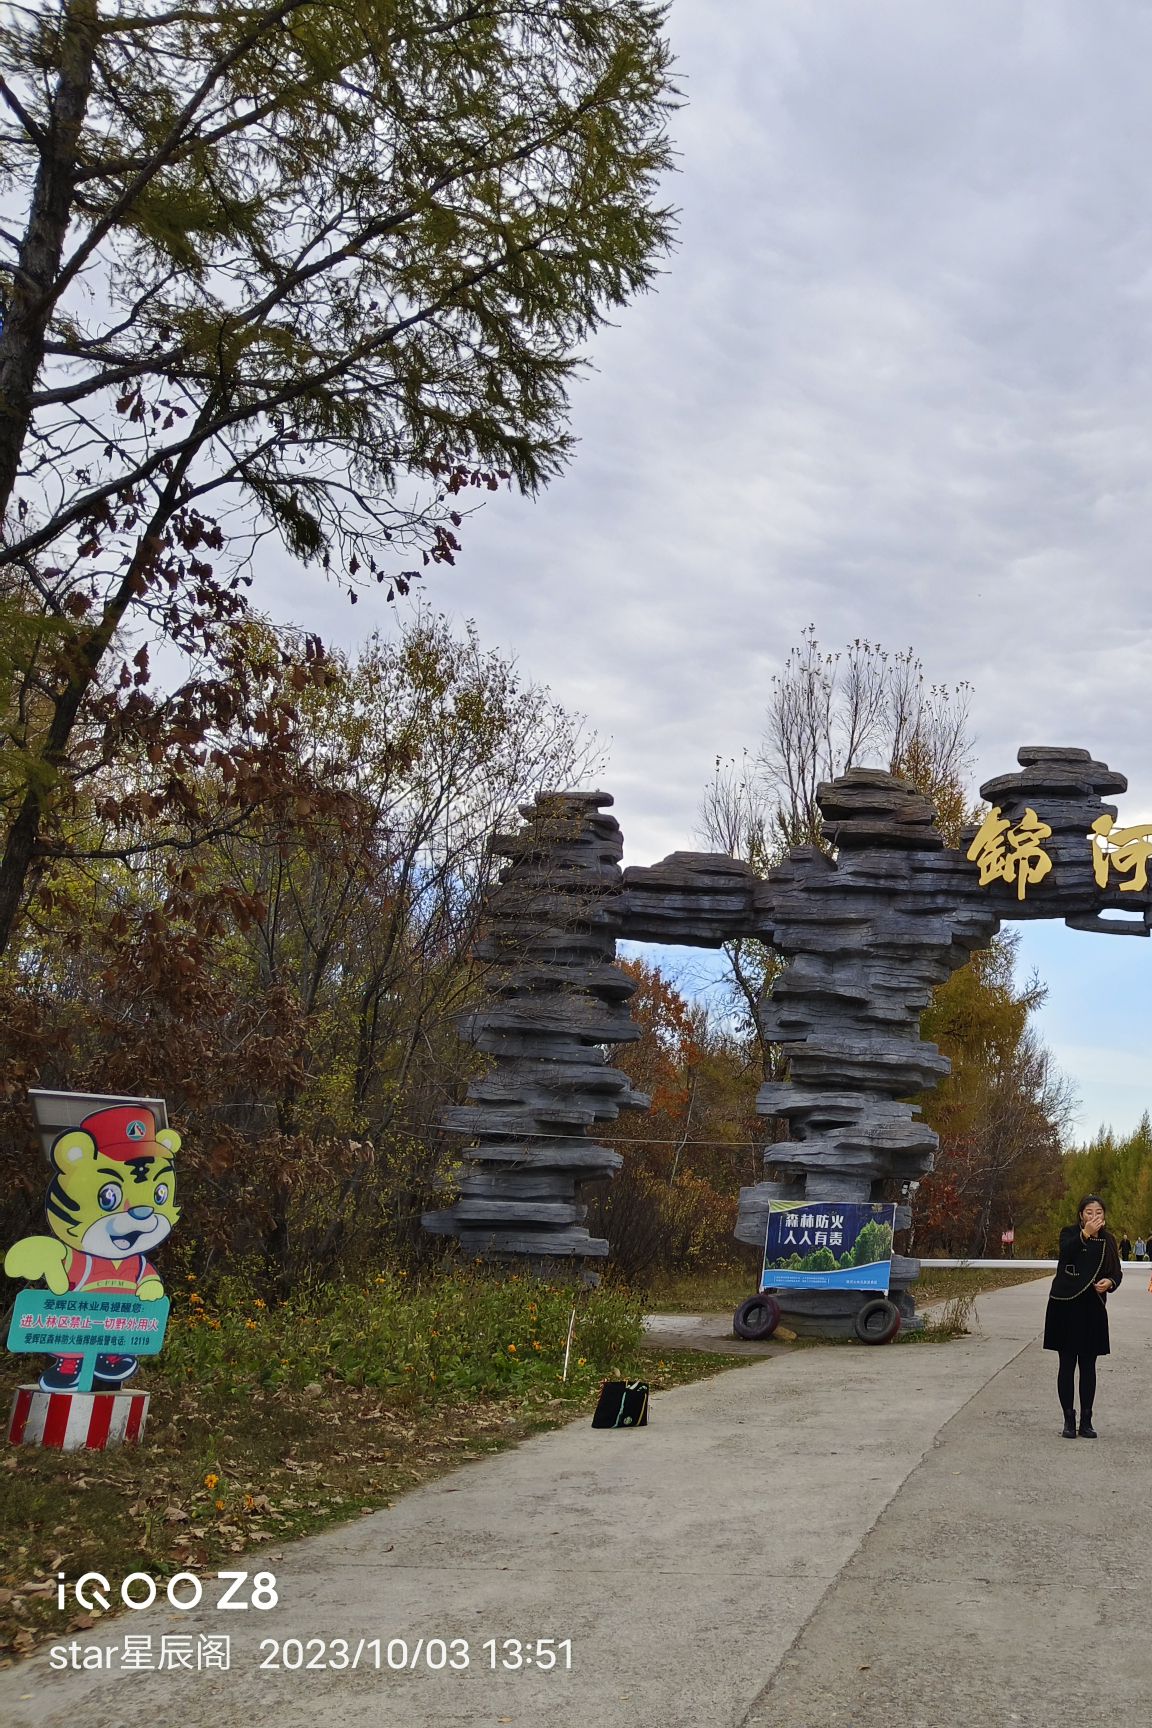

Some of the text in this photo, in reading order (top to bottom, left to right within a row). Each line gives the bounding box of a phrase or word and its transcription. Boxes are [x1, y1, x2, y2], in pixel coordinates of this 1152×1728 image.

[785, 1213, 844, 1229] 森林防火
[783, 1230, 843, 1246] 人人有责
[130, 1335, 150, 1345] 12119
